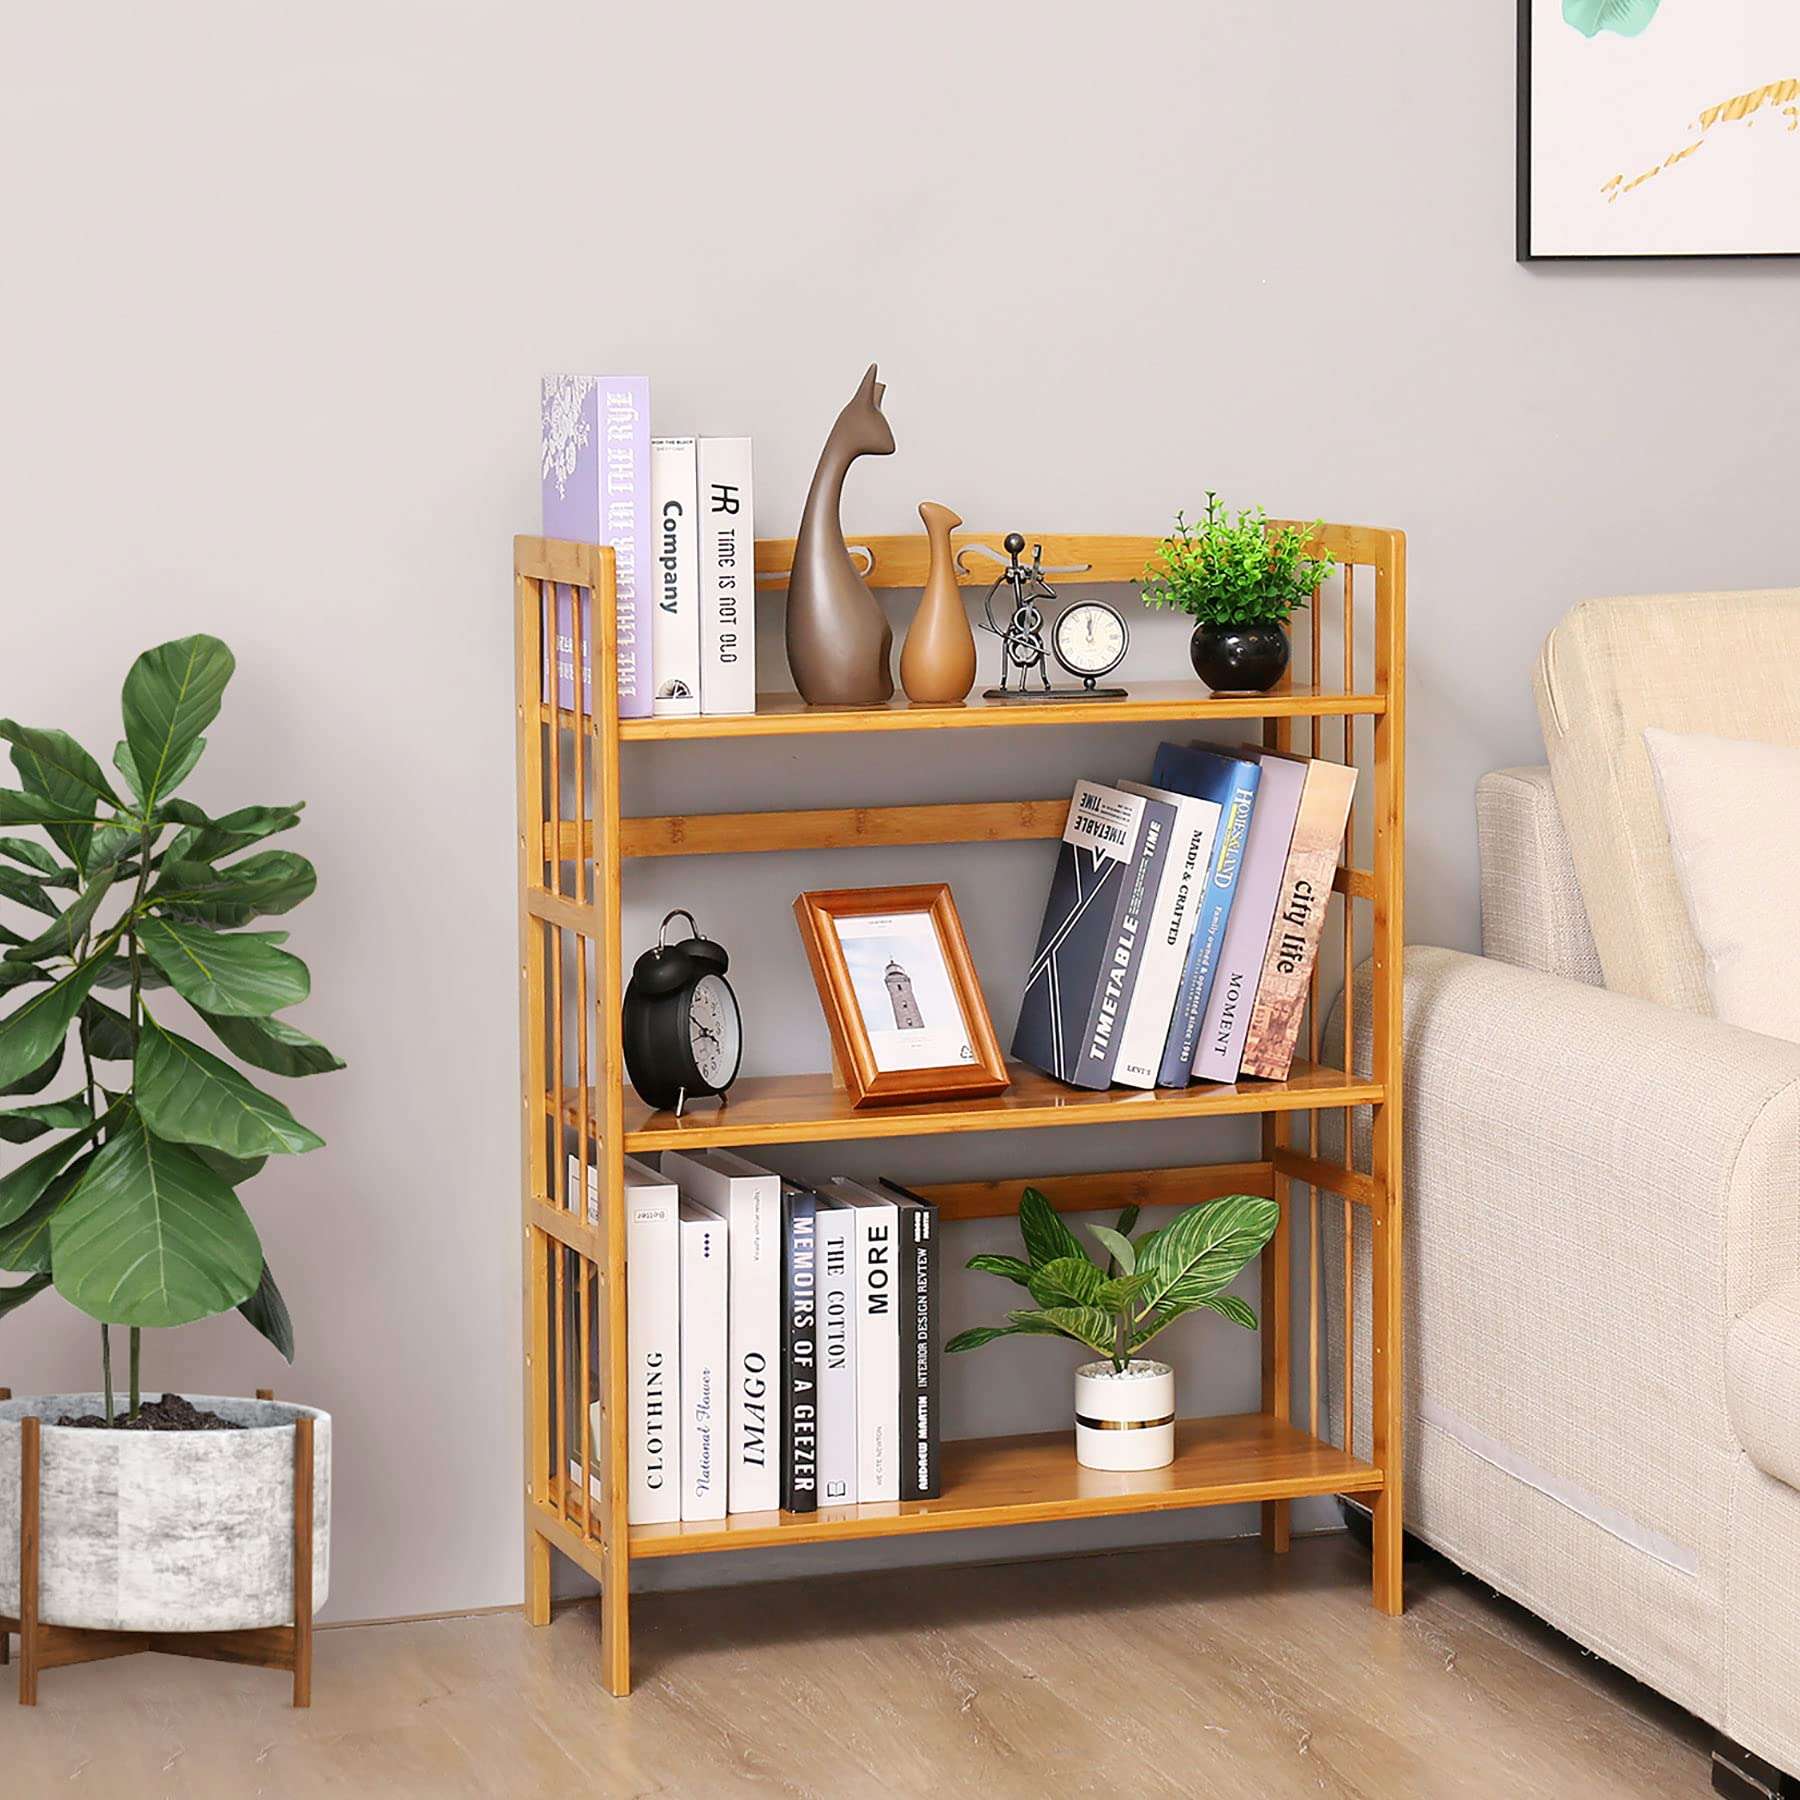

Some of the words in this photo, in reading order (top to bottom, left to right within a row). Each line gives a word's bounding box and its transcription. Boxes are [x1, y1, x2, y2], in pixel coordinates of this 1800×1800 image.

[606, 391, 640, 441] RYE
[607, 447, 634, 496] THE
[710, 484, 739, 517] HR
[659, 501, 683, 615] Company
[719, 634, 738, 663] OLD
[1080, 791, 1103, 814] TIME
[1073, 815, 1127, 847] TIMETABLE
[1185, 829, 1203, 870] MADE
[1182, 871, 1192, 881] &
[1167, 883, 1190, 946] CRAFTED
[1208, 905, 1222, 934] Family
[1283, 879, 1312, 930] city
[1089, 916, 1140, 1061] TIMETABLE
[1143, 820, 1162, 857] TIME
[1202, 937, 1214, 966] owned
[1277, 929, 1306, 974] life
[1190, 974, 1206, 1014] operated
[1213, 972, 1243, 1057] MOMENT
[1185, 1016, 1196, 1038] since
[792, 1216, 814, 1329] MEMOIRS
[826, 1236, 845, 1276] THE
[868, 1224, 889, 1314] MORE
[826, 1290, 846, 1369] COTTON
[917, 1295, 928, 1340] DESIGN
[792, 1341, 815, 1368] OF
[917, 1342, 928, 1388] INTERIOR
[695, 1367, 711, 1422] Flower
[793, 1378, 815, 1393] A
[646, 1351, 663, 1490] CLOTHING
[743, 1351, 767, 1468] IMAGO
[917, 1395, 929, 1439] MARTIN
[695, 1425, 711, 1498] National
[792, 1406, 815, 1493] GEEZER
[918, 1442, 929, 1490] ANDREW
